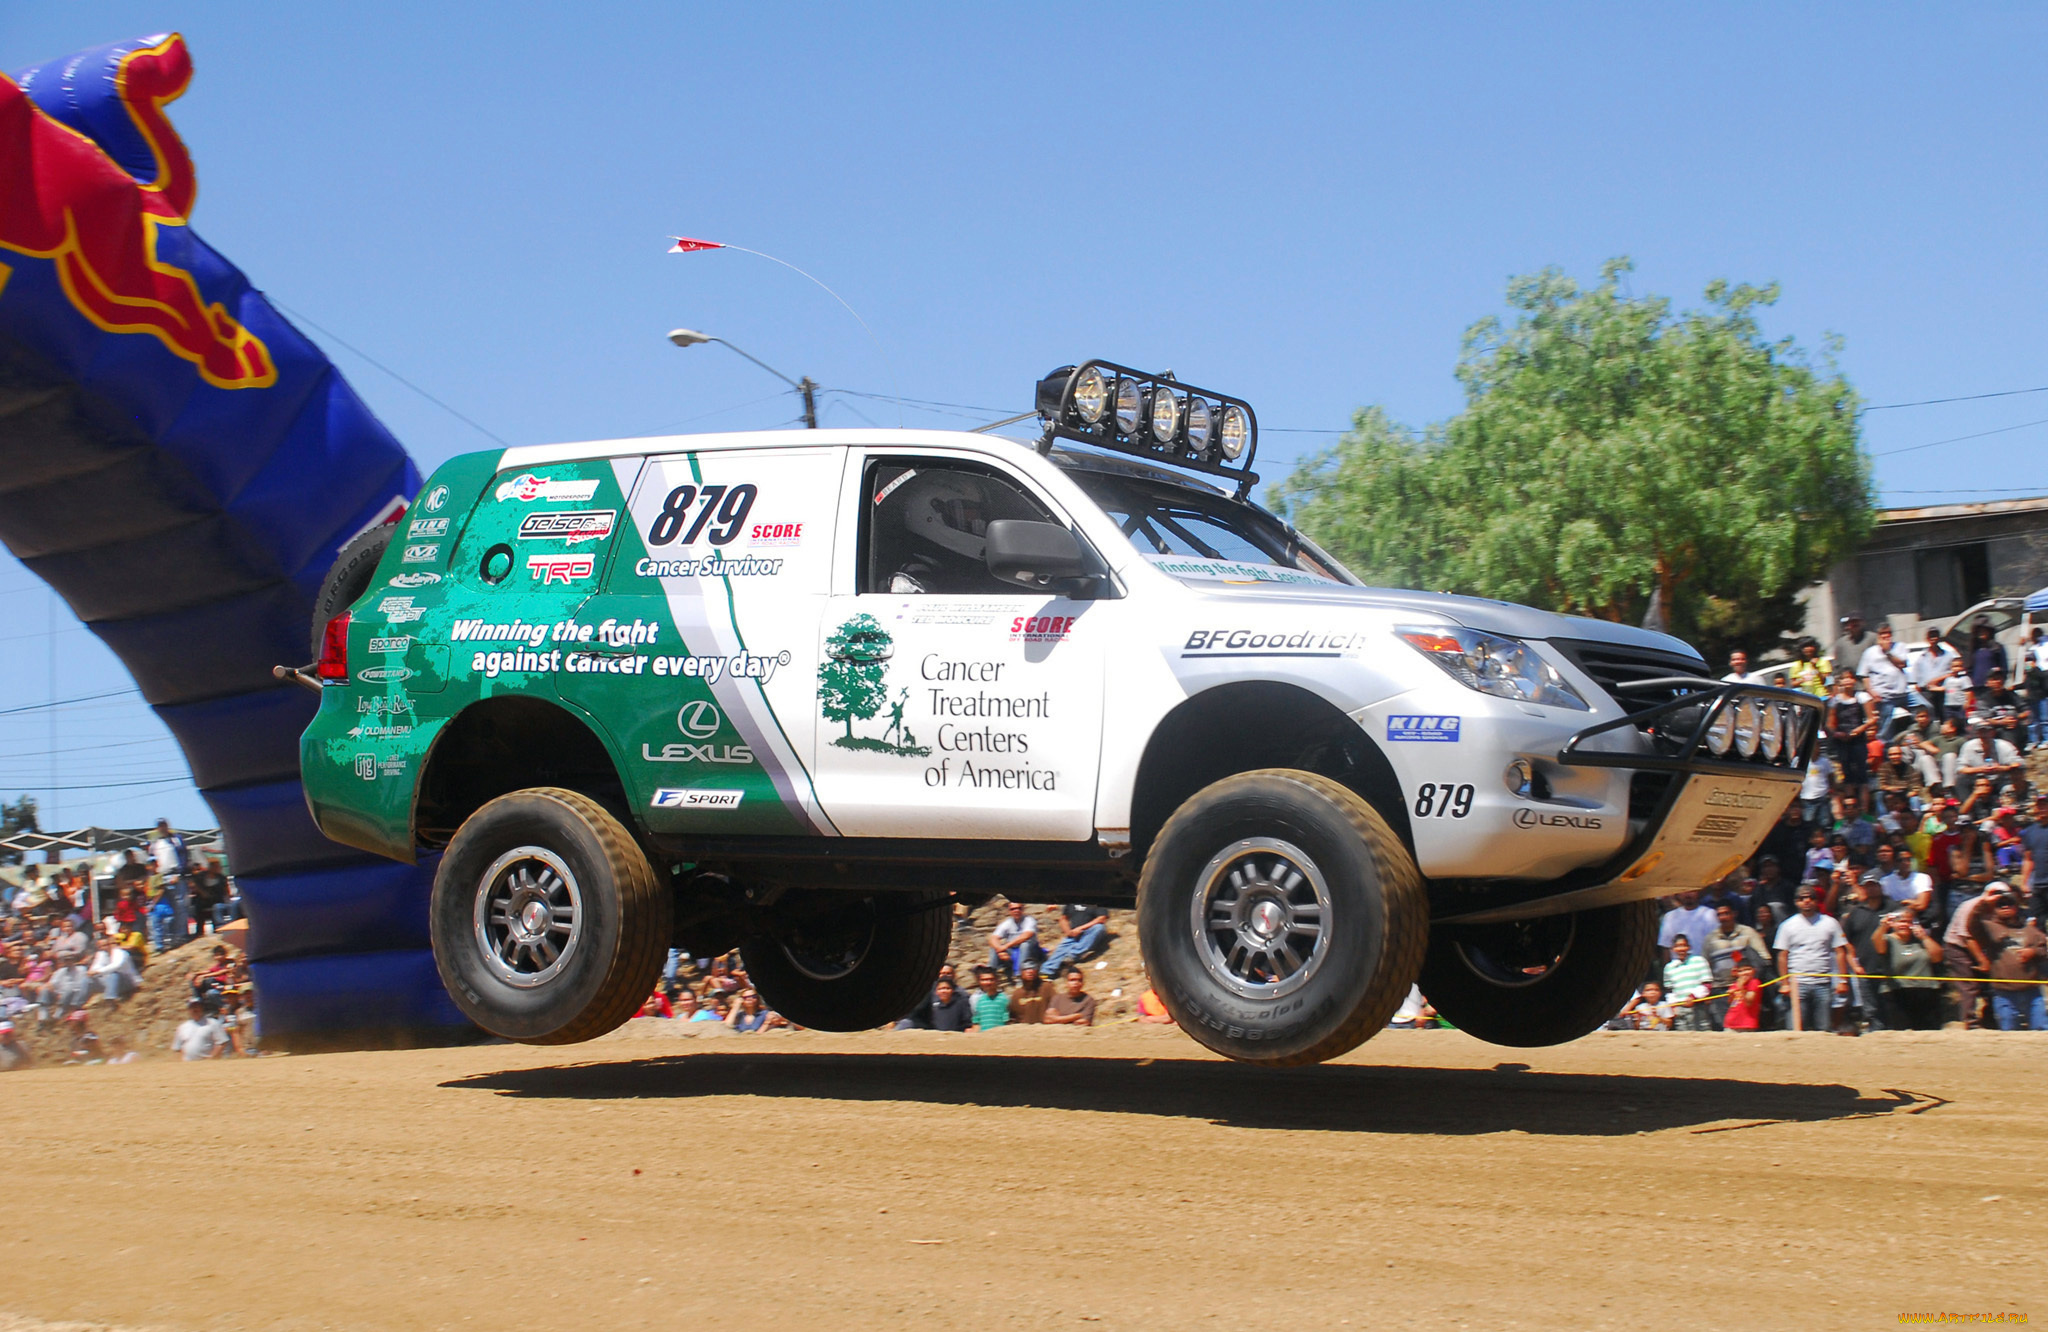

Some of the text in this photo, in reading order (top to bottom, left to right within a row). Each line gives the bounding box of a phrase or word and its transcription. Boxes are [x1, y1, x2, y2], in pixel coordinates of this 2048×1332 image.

[427, 486, 448, 511] KC
[412, 519, 448, 530] KING
[649, 484, 758, 546] 879
[751, 523, 804, 538] SCORE
[528, 562, 593, 583] TRD
[635, 554, 783, 577] Cancer Survivor
[1212, 562, 1239, 575] the
[1236, 563, 1273, 580] fight
[450, 617, 660, 647] Winning the fight
[1011, 616, 1076, 633] SCORE
[370, 638, 408, 651] sparco
[1184, 630, 1368, 650] BFGoodrich
[472, 646, 562, 678] against
[564, 651, 650, 676] cancer
[651, 654, 728, 684] every
[921, 653, 1006, 682] Cancer
[928, 688, 1051, 718] Treatment
[1388, 716, 1459, 730] KING
[938, 723, 1029, 753] Centers
[642, 743, 754, 763] LEXUS
[924, 757, 1057, 791] of America
[687, 794, 739, 804] SPORT
[1414, 783, 1476, 819] 879
[1540, 815, 1603, 830] LEXUS
